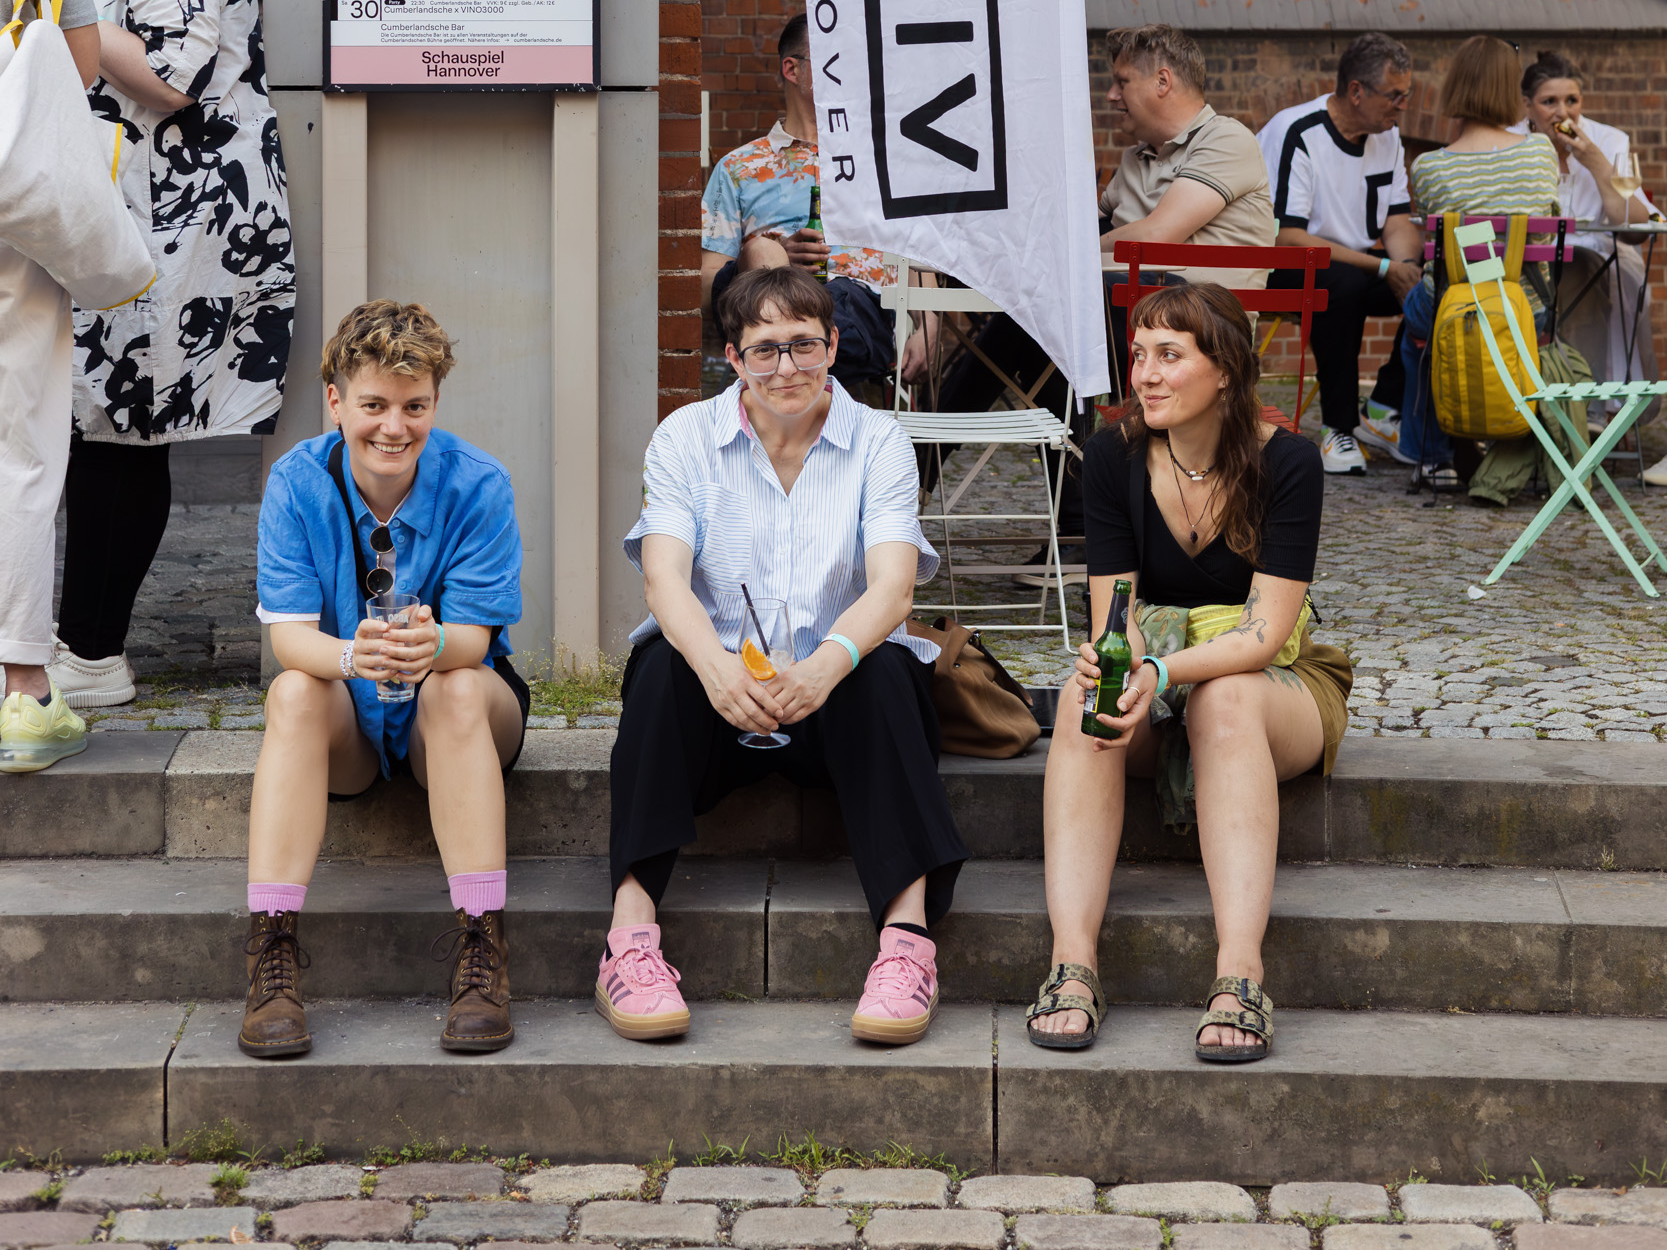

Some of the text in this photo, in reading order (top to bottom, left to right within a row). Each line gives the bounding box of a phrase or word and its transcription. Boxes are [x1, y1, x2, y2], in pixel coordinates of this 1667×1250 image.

[351, 0, 379, 19] 30
[381, 23, 450, 31] Cumberlandsche
[422, 50, 504, 66] Schauspiel
[427, 64, 501, 77] Hannover
